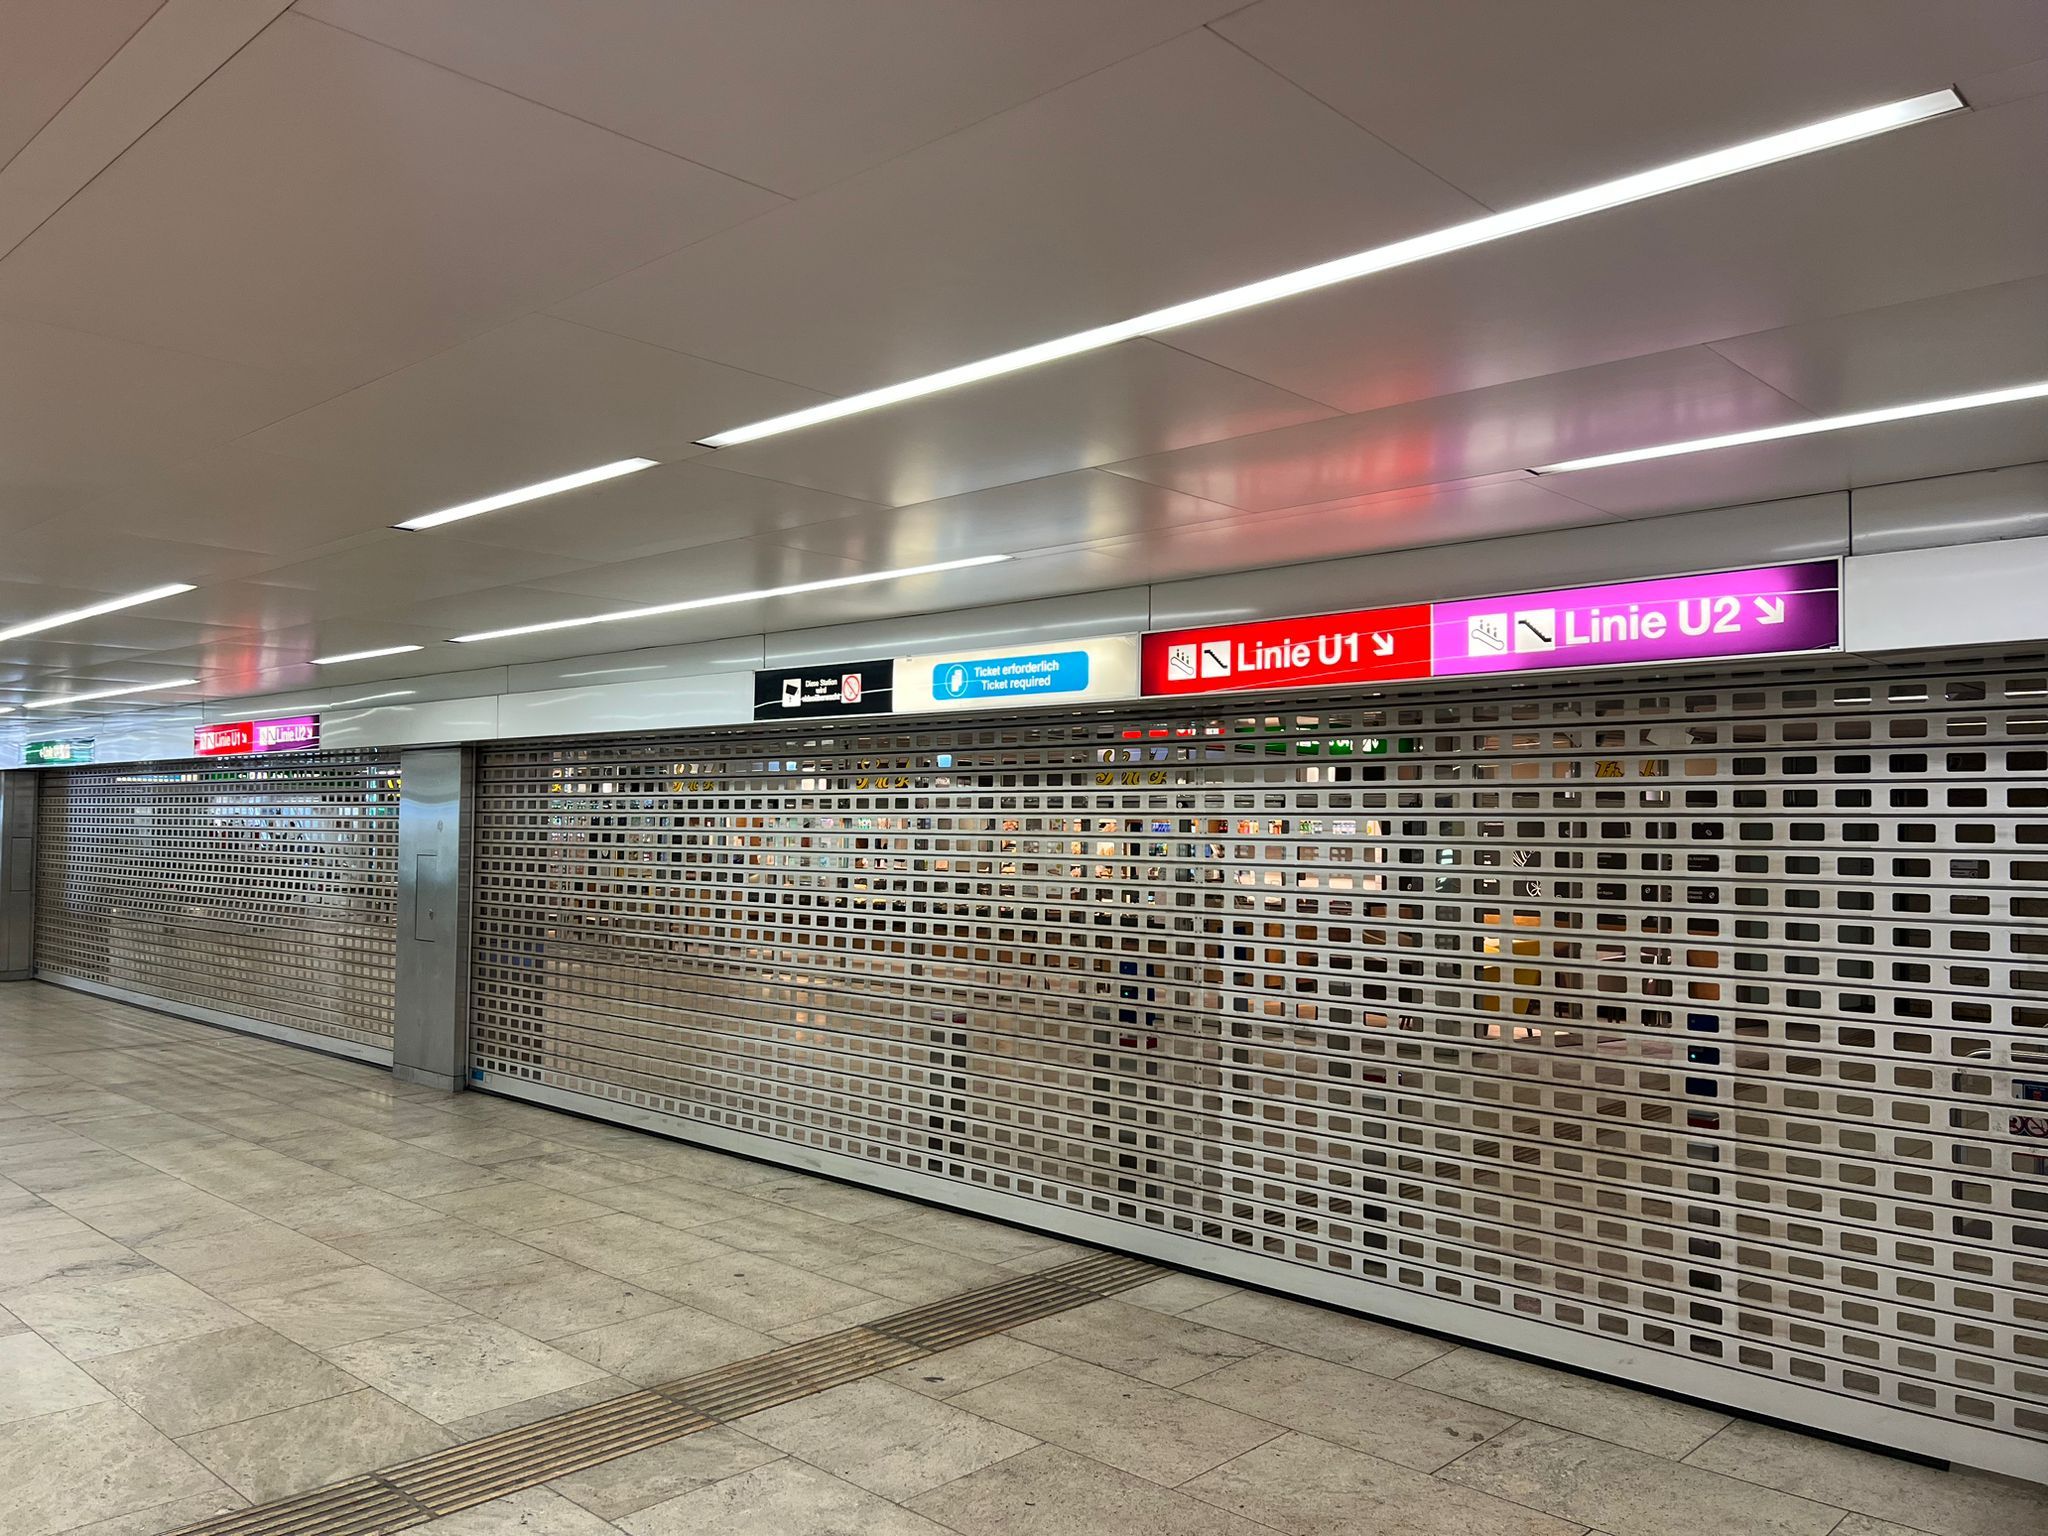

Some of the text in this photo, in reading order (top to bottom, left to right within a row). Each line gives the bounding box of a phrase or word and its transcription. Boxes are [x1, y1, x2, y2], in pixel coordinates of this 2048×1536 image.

[1565, 596, 1742, 645] Linie U2
[1237, 632, 1358, 672] Linie U1
[974, 659, 1060, 677] Ticket erforderlich
[820, 678, 838, 686] Station
[981, 674, 1051, 691] Ticket required
[215, 731, 240, 747] Linie U1
[277, 725, 306, 742] Linie U2
